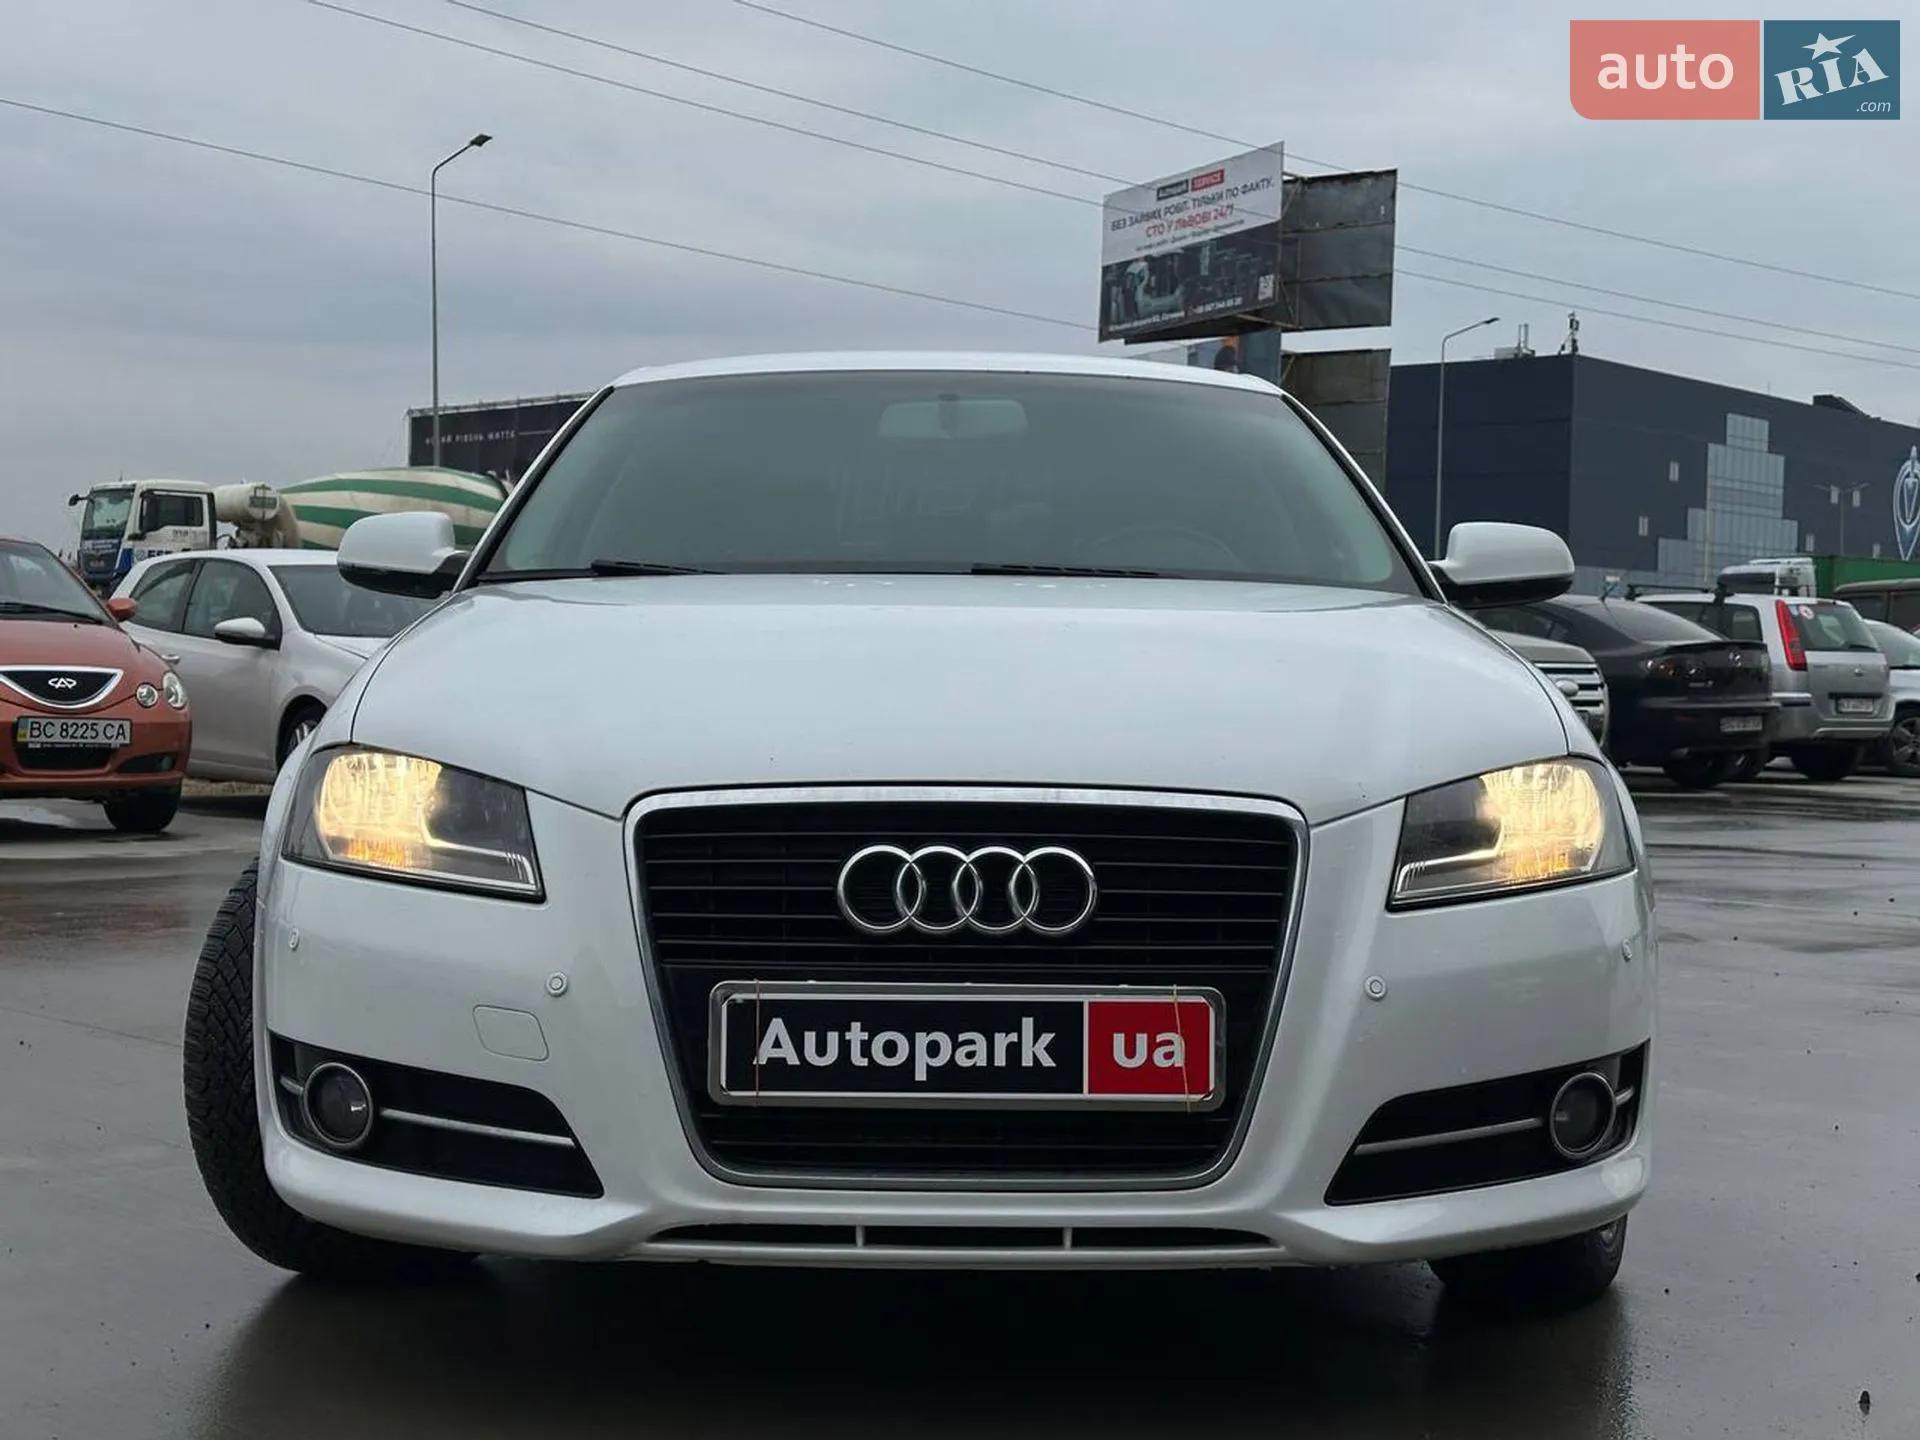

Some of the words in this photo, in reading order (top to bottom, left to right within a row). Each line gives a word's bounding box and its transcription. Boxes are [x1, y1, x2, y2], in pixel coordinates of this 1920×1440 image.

[1111, 217, 1127, 231] БЕЗ
[1225, 186, 1239, 200] ПО
[1145, 222, 1165, 238] СТО
[29, 721, 55, 739] BC
[59, 722, 99, 740] 8225
[103, 723, 126, 740] CA
[754, 1017, 1056, 1081] Autopark
[1112, 1032, 1185, 1069] ua
